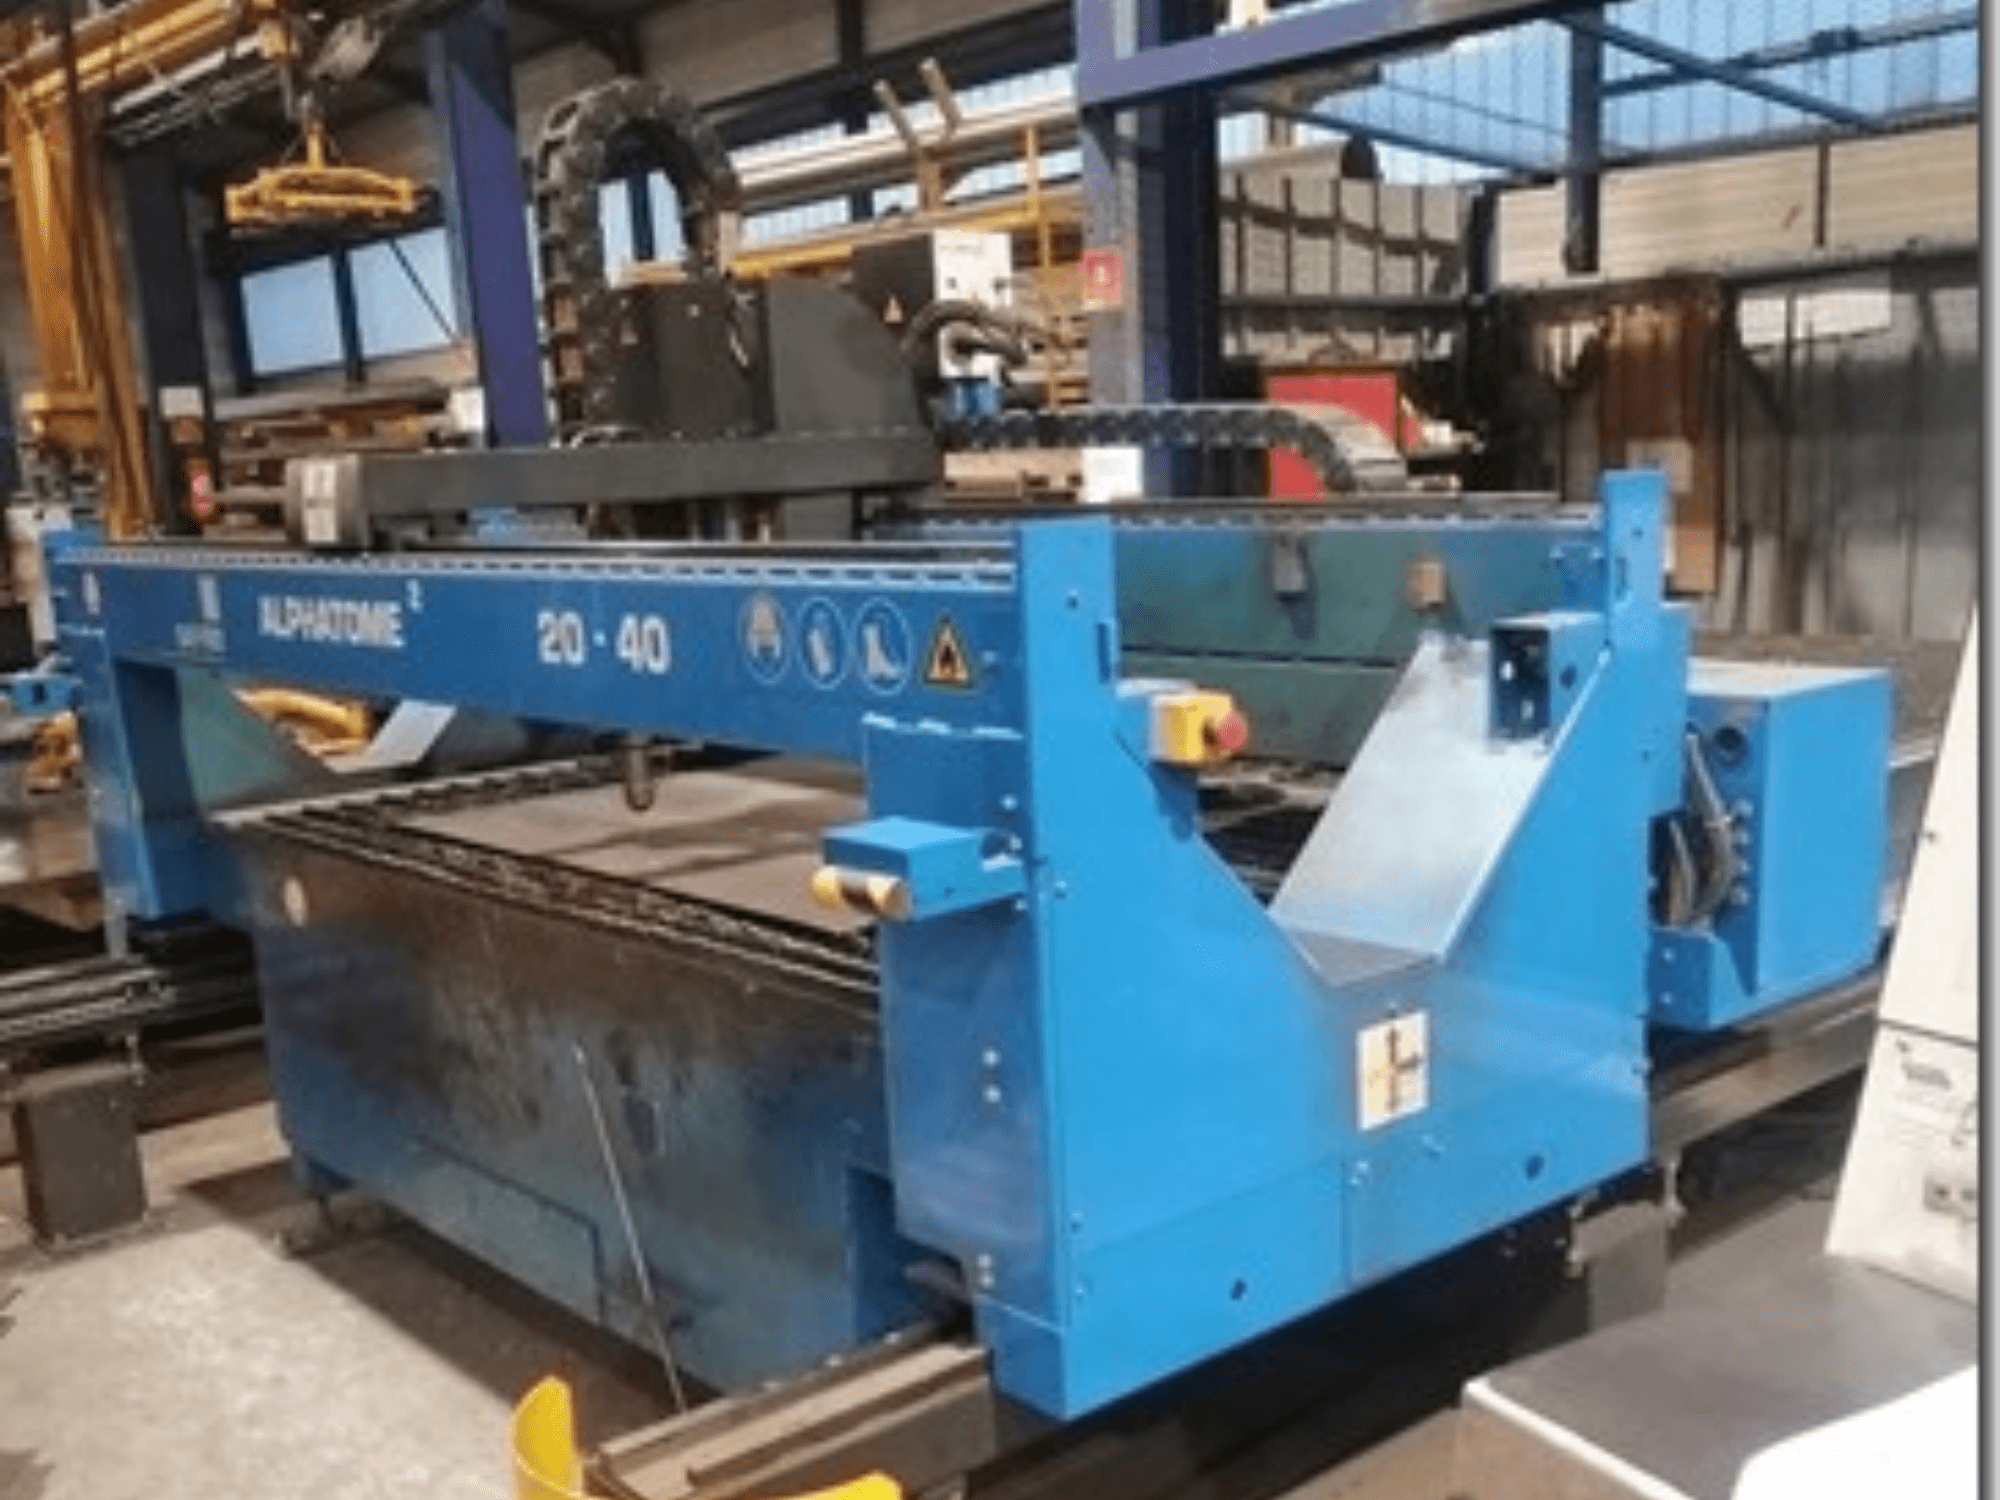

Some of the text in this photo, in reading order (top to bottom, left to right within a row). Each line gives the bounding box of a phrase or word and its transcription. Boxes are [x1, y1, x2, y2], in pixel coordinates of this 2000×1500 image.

[258, 596, 404, 648] ALPHATOME
[537, 609, 586, 666] 20
[616, 612, 672, 675] 40
